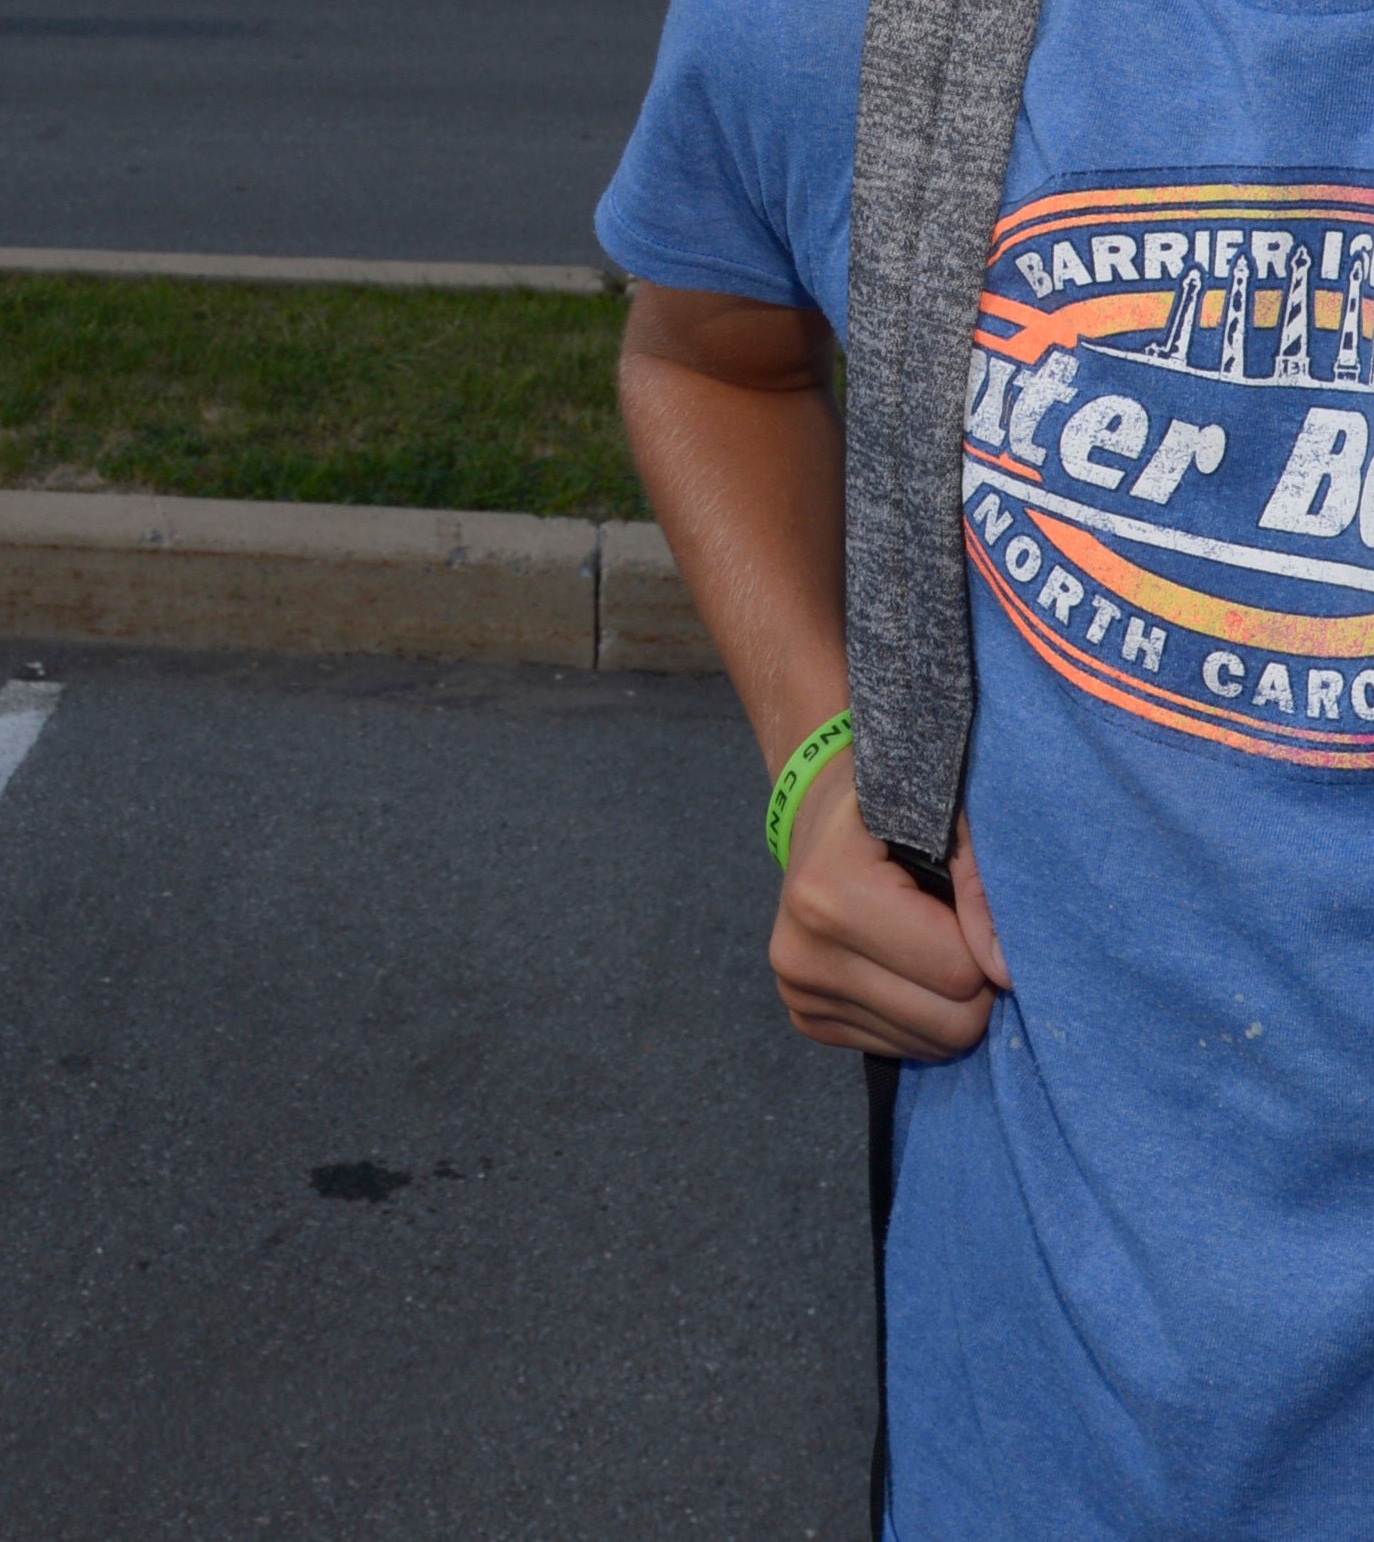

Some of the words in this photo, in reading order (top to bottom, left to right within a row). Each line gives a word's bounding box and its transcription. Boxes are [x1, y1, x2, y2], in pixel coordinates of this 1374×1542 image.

[1014, 229, 1294, 298] BARRIER
[963, 348, 1227, 506] uter
[971, 491, 1167, 674] NORTH
[803, 718, 852, 763] ING
[769, 770, 798, 861] CENT
